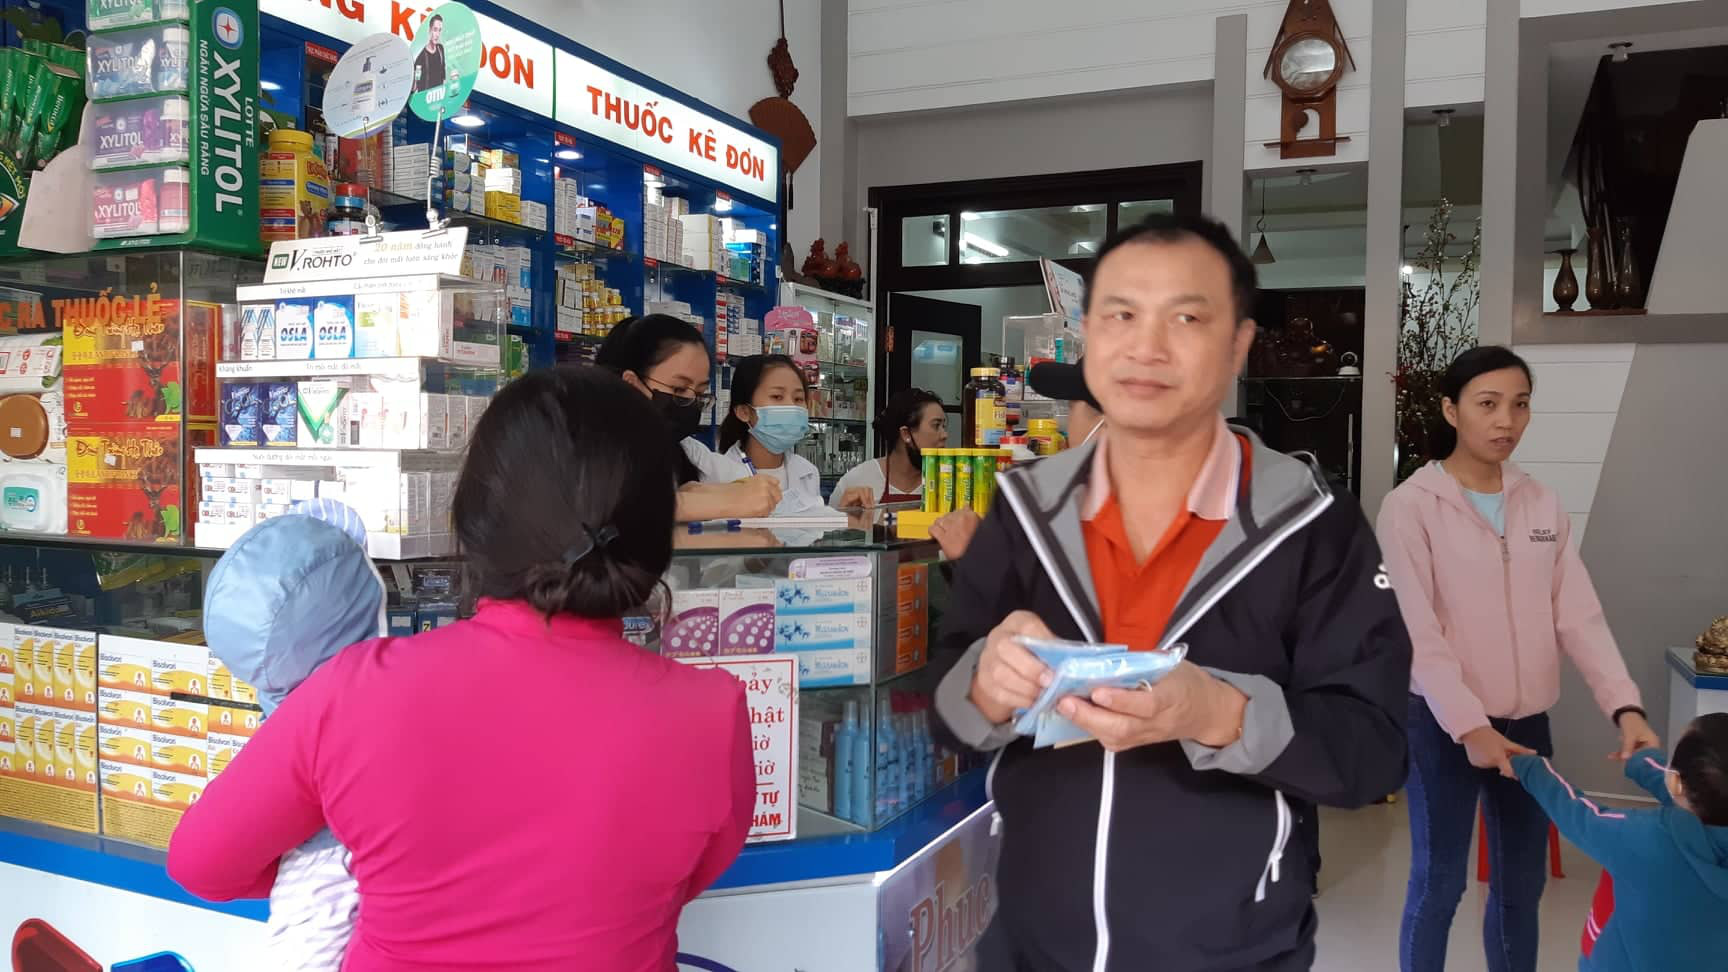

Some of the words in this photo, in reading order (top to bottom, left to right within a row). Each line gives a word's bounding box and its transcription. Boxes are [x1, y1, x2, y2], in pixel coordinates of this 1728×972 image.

[320, 0, 364, 23] G
[391, 2, 433, 41] K
[480, 42, 534, 89] ƠN
[213, 51, 243, 213] XYLITOL
[244, 97, 255, 149] LOTTE
[100, 132, 144, 149] XYLITOL
[586, 85, 673, 144] THUỐC
[688, 128, 717, 162] KÊ
[725, 144, 765, 181] ĐƠN
[98, 202, 142, 218] XYLITOL
[51, 287, 127, 328] THUỐC
[133, 282, 161, 323] LẺ
[280, 327, 307, 342] OSLA
[319, 325, 347, 341] OSLA
[748, 672, 773, 695] ảy
[751, 706, 785, 728] hật
[753, 734, 771, 751] iờ
[755, 760, 776, 776] iờ
[761, 790, 780, 808] TỰ
[752, 811, 782, 827] HÁM
